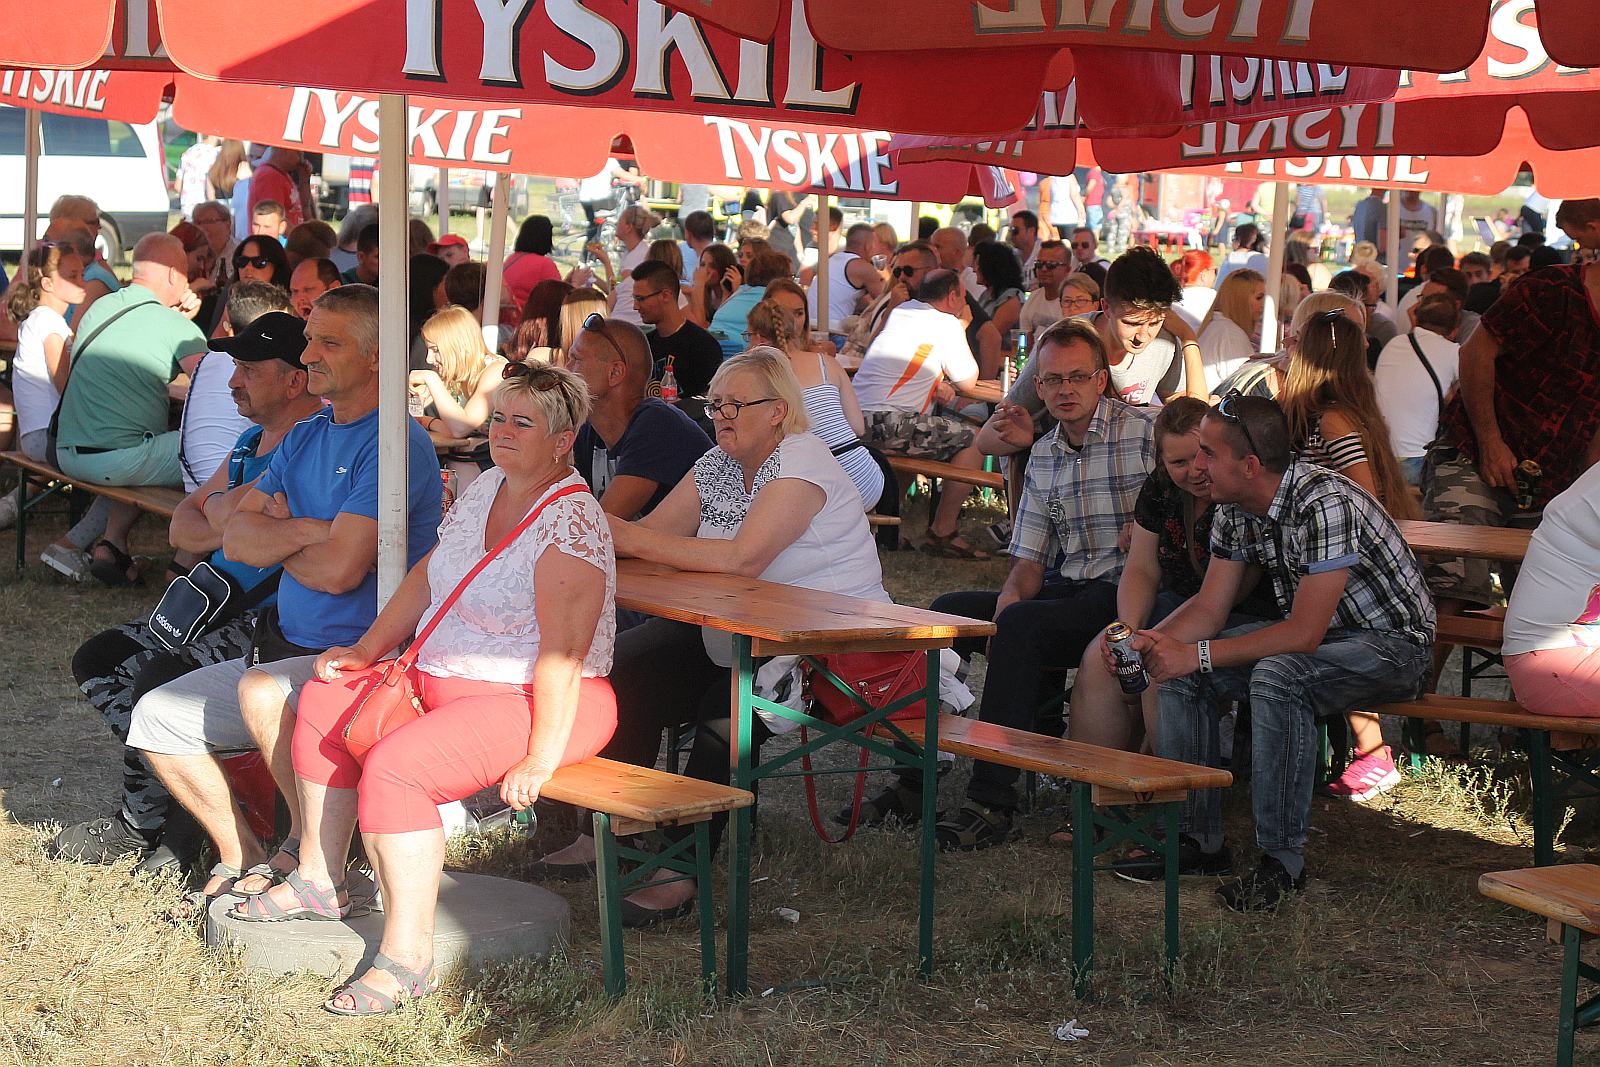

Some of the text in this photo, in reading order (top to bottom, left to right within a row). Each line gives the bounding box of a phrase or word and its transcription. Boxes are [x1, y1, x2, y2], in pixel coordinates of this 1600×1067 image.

[280, 86, 522, 165] TYSKIE
[703, 115, 899, 195] TYSKIE
[156, 613, 173, 632] adidas
